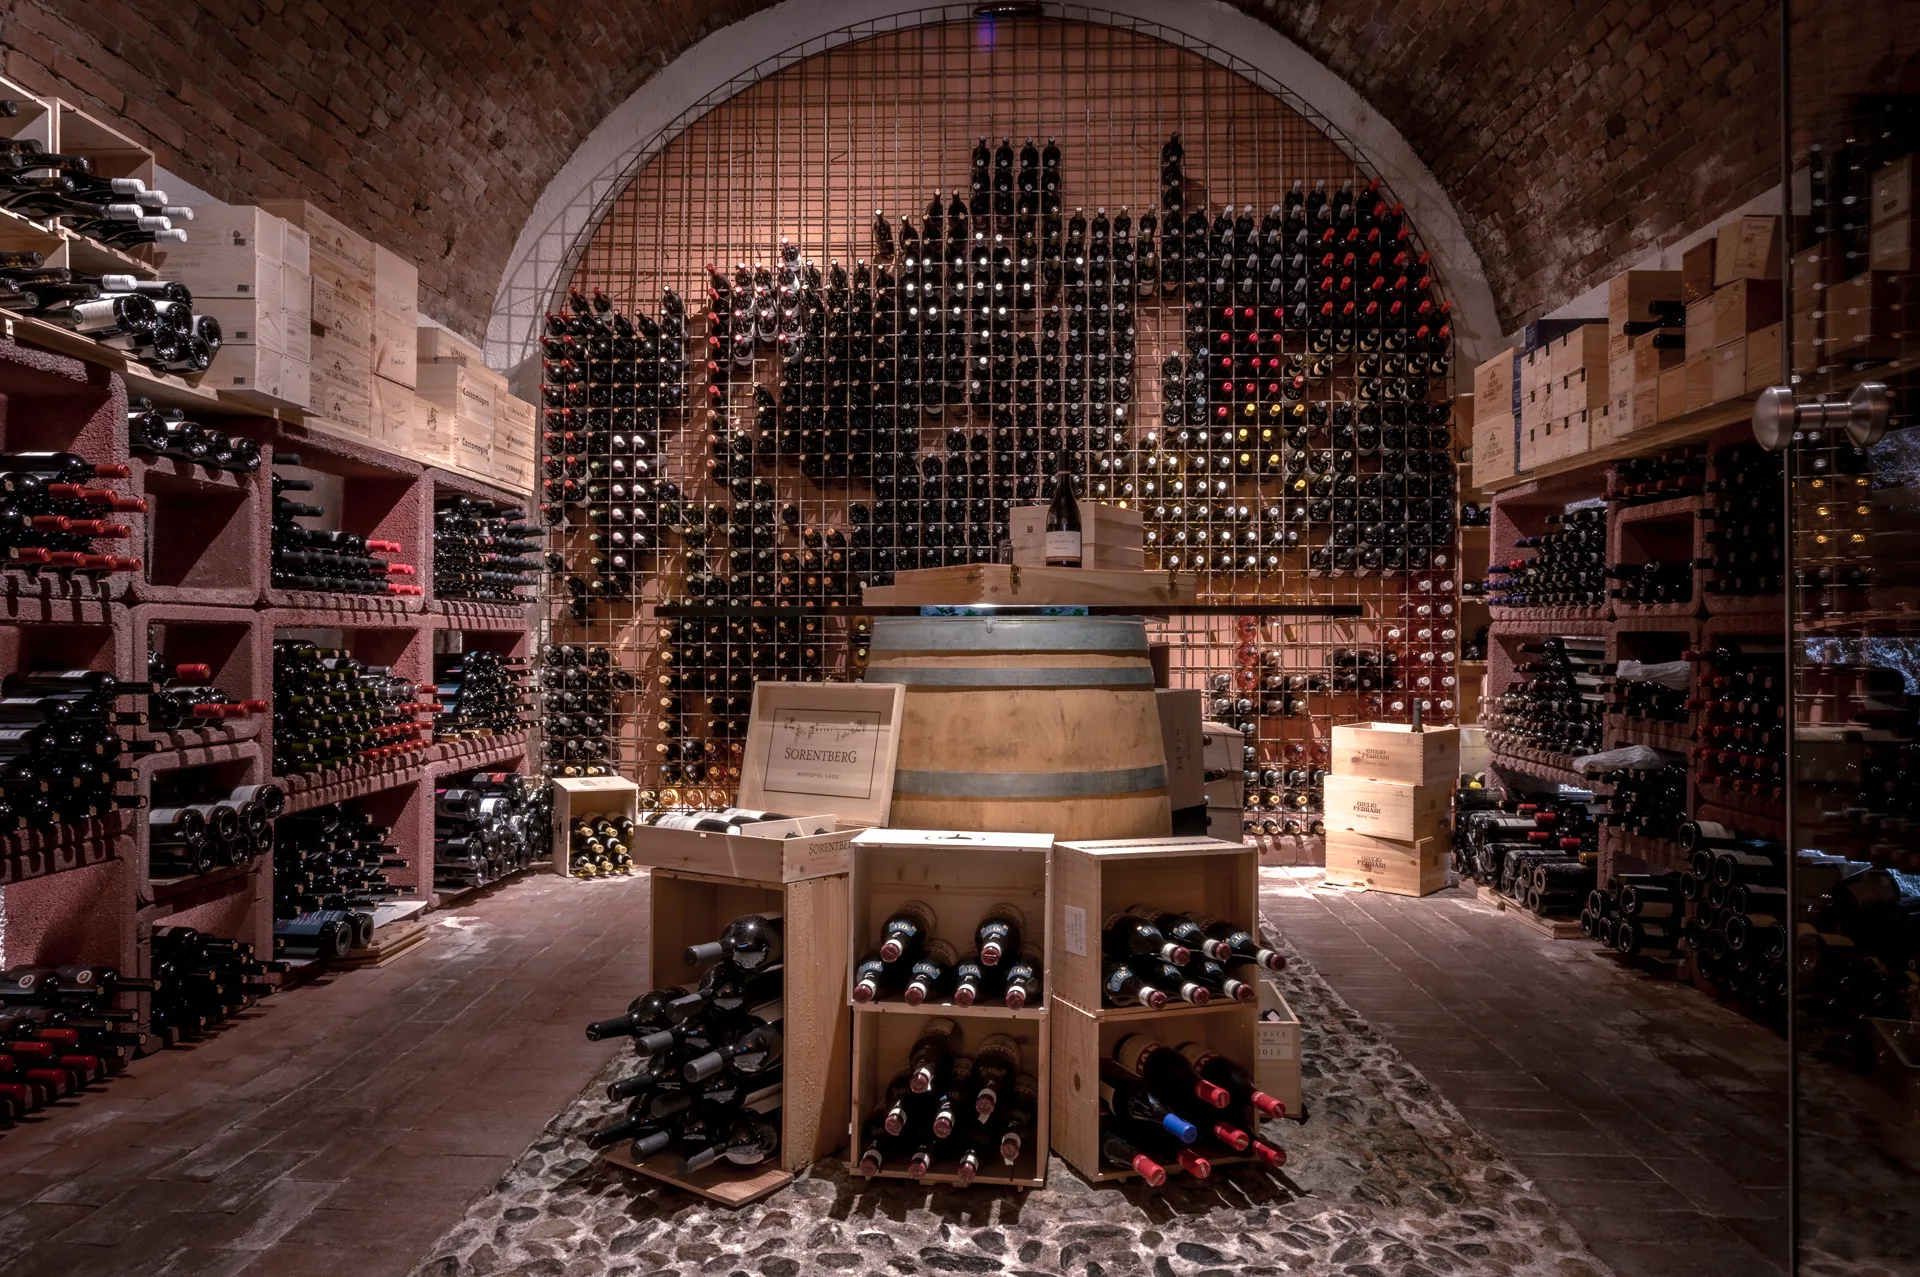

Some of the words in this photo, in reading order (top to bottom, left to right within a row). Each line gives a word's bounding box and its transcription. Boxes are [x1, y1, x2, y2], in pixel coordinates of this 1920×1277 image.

[784, 747, 857, 763] SORENTBERG
[1361, 752, 1390, 761] FERRARI
[1365, 748, 1387, 756] GIULIO
[1353, 805, 1381, 814] FERRARI
[1356, 801, 1378, 809] GIULIO
[808, 840, 851, 856] SORENTBE
[1357, 859, 1387, 869] FERRARI
[1361, 856, 1383, 864] GIULIO
